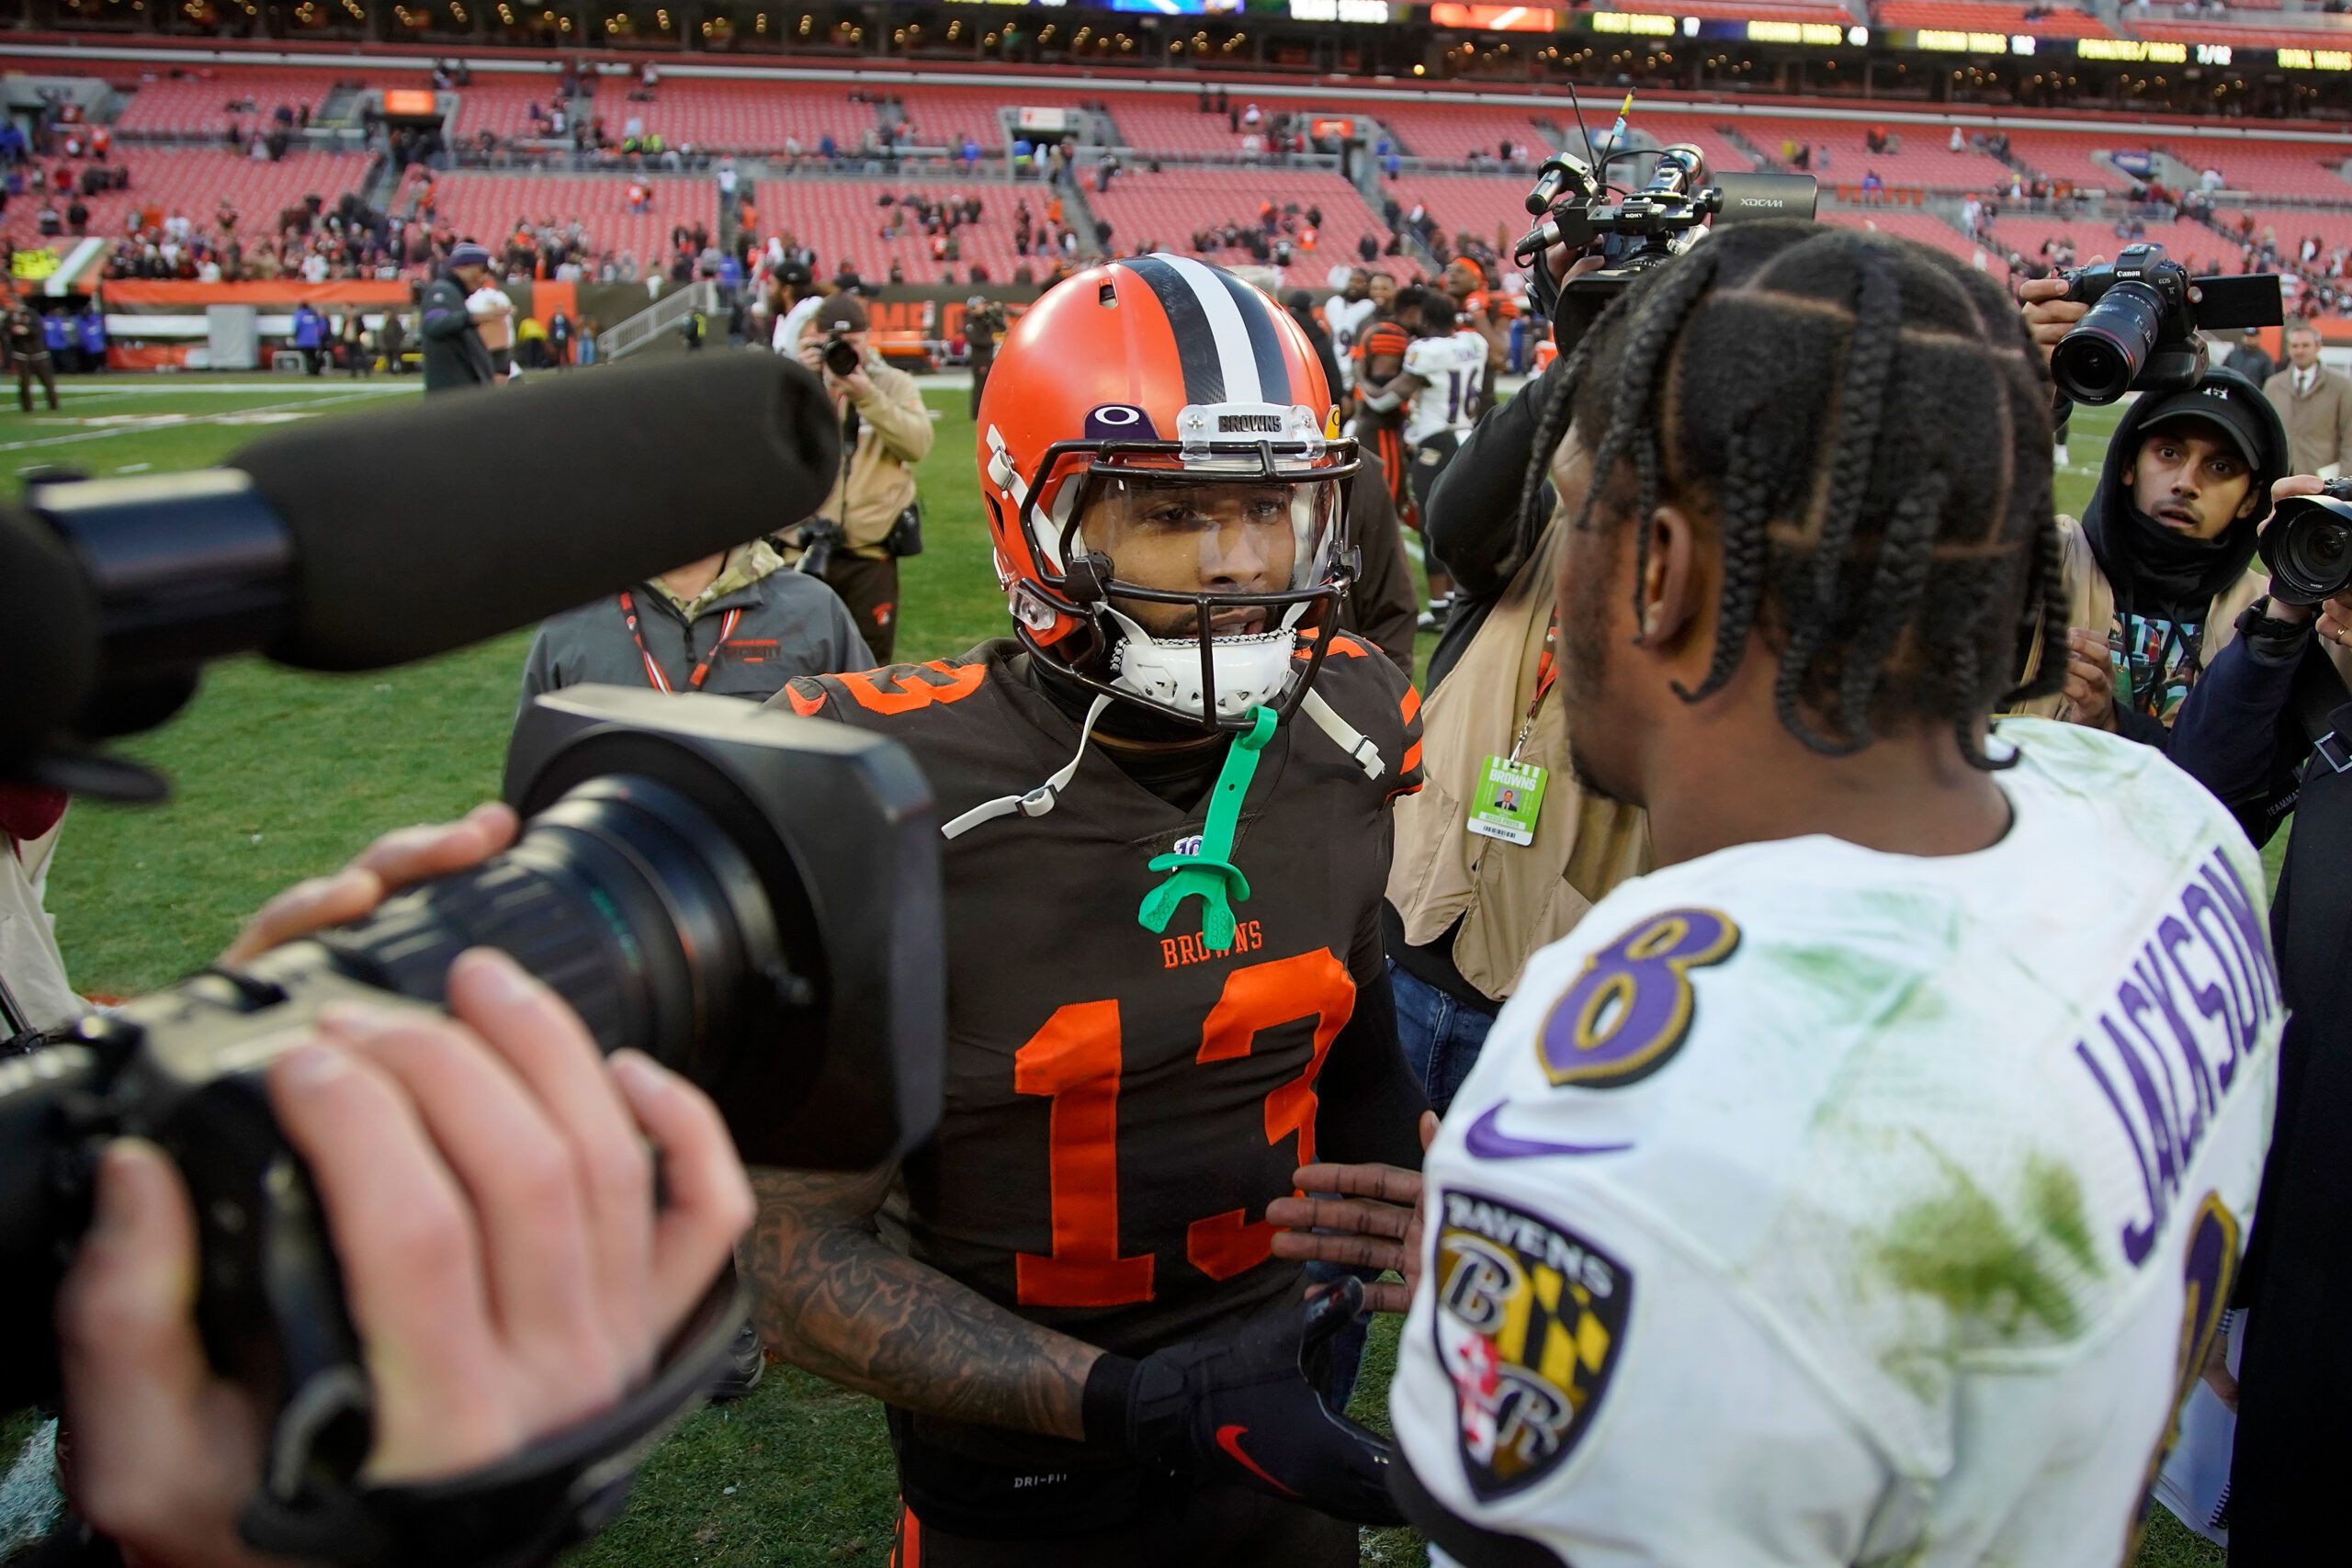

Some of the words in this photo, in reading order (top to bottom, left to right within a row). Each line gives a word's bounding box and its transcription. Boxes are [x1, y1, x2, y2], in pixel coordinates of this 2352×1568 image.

[1740, 197, 1783, 208] XDCAM
[1218, 414, 1283, 433] BROWNS
[1447, 367, 1482, 423] 16
[1489, 768, 1537, 792] BROWNS
[1536, 907, 1742, 1089] 8
[2075, 845, 2283, 1267] JACKSON
[1015, 946, 1356, 1307] 13
[1445, 1191, 1614, 1299] RAVENS
